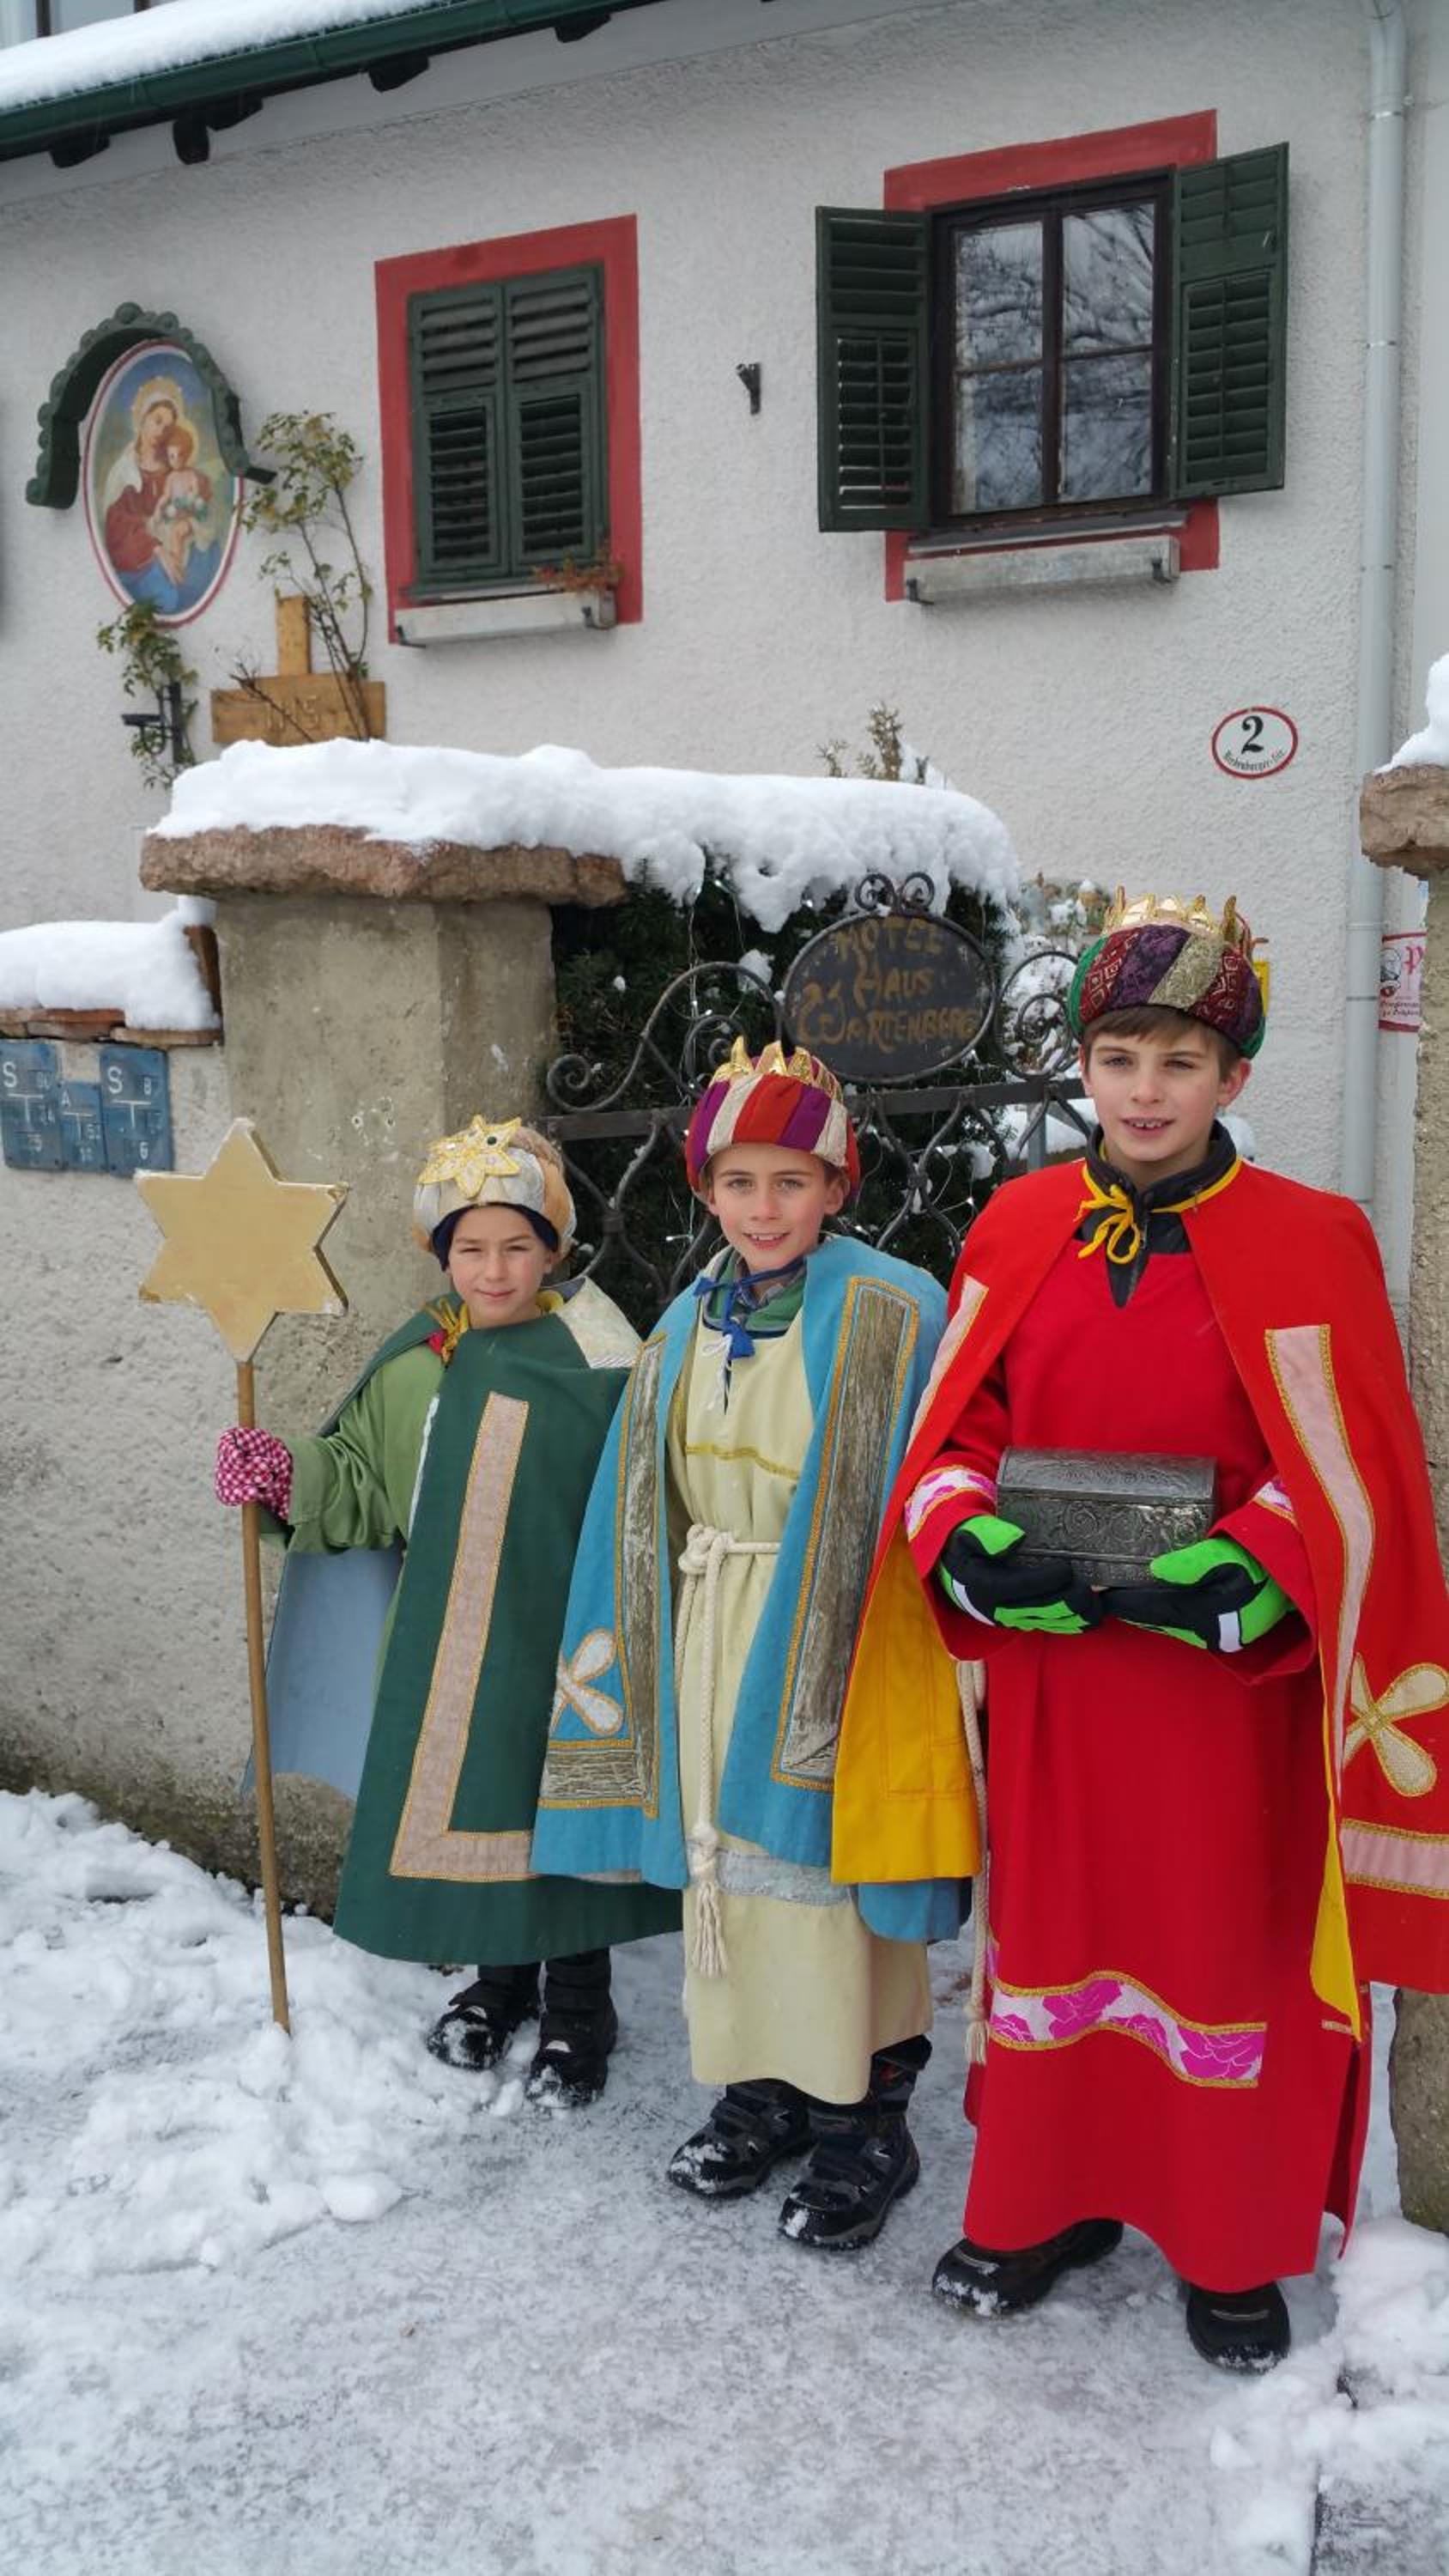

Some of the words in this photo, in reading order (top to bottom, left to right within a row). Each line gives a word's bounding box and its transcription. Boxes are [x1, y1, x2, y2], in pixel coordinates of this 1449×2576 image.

[1241, 715, 1264, 755] 2
[3, 1061, 17, 1088] S
[107, 1066, 123, 1093] S
